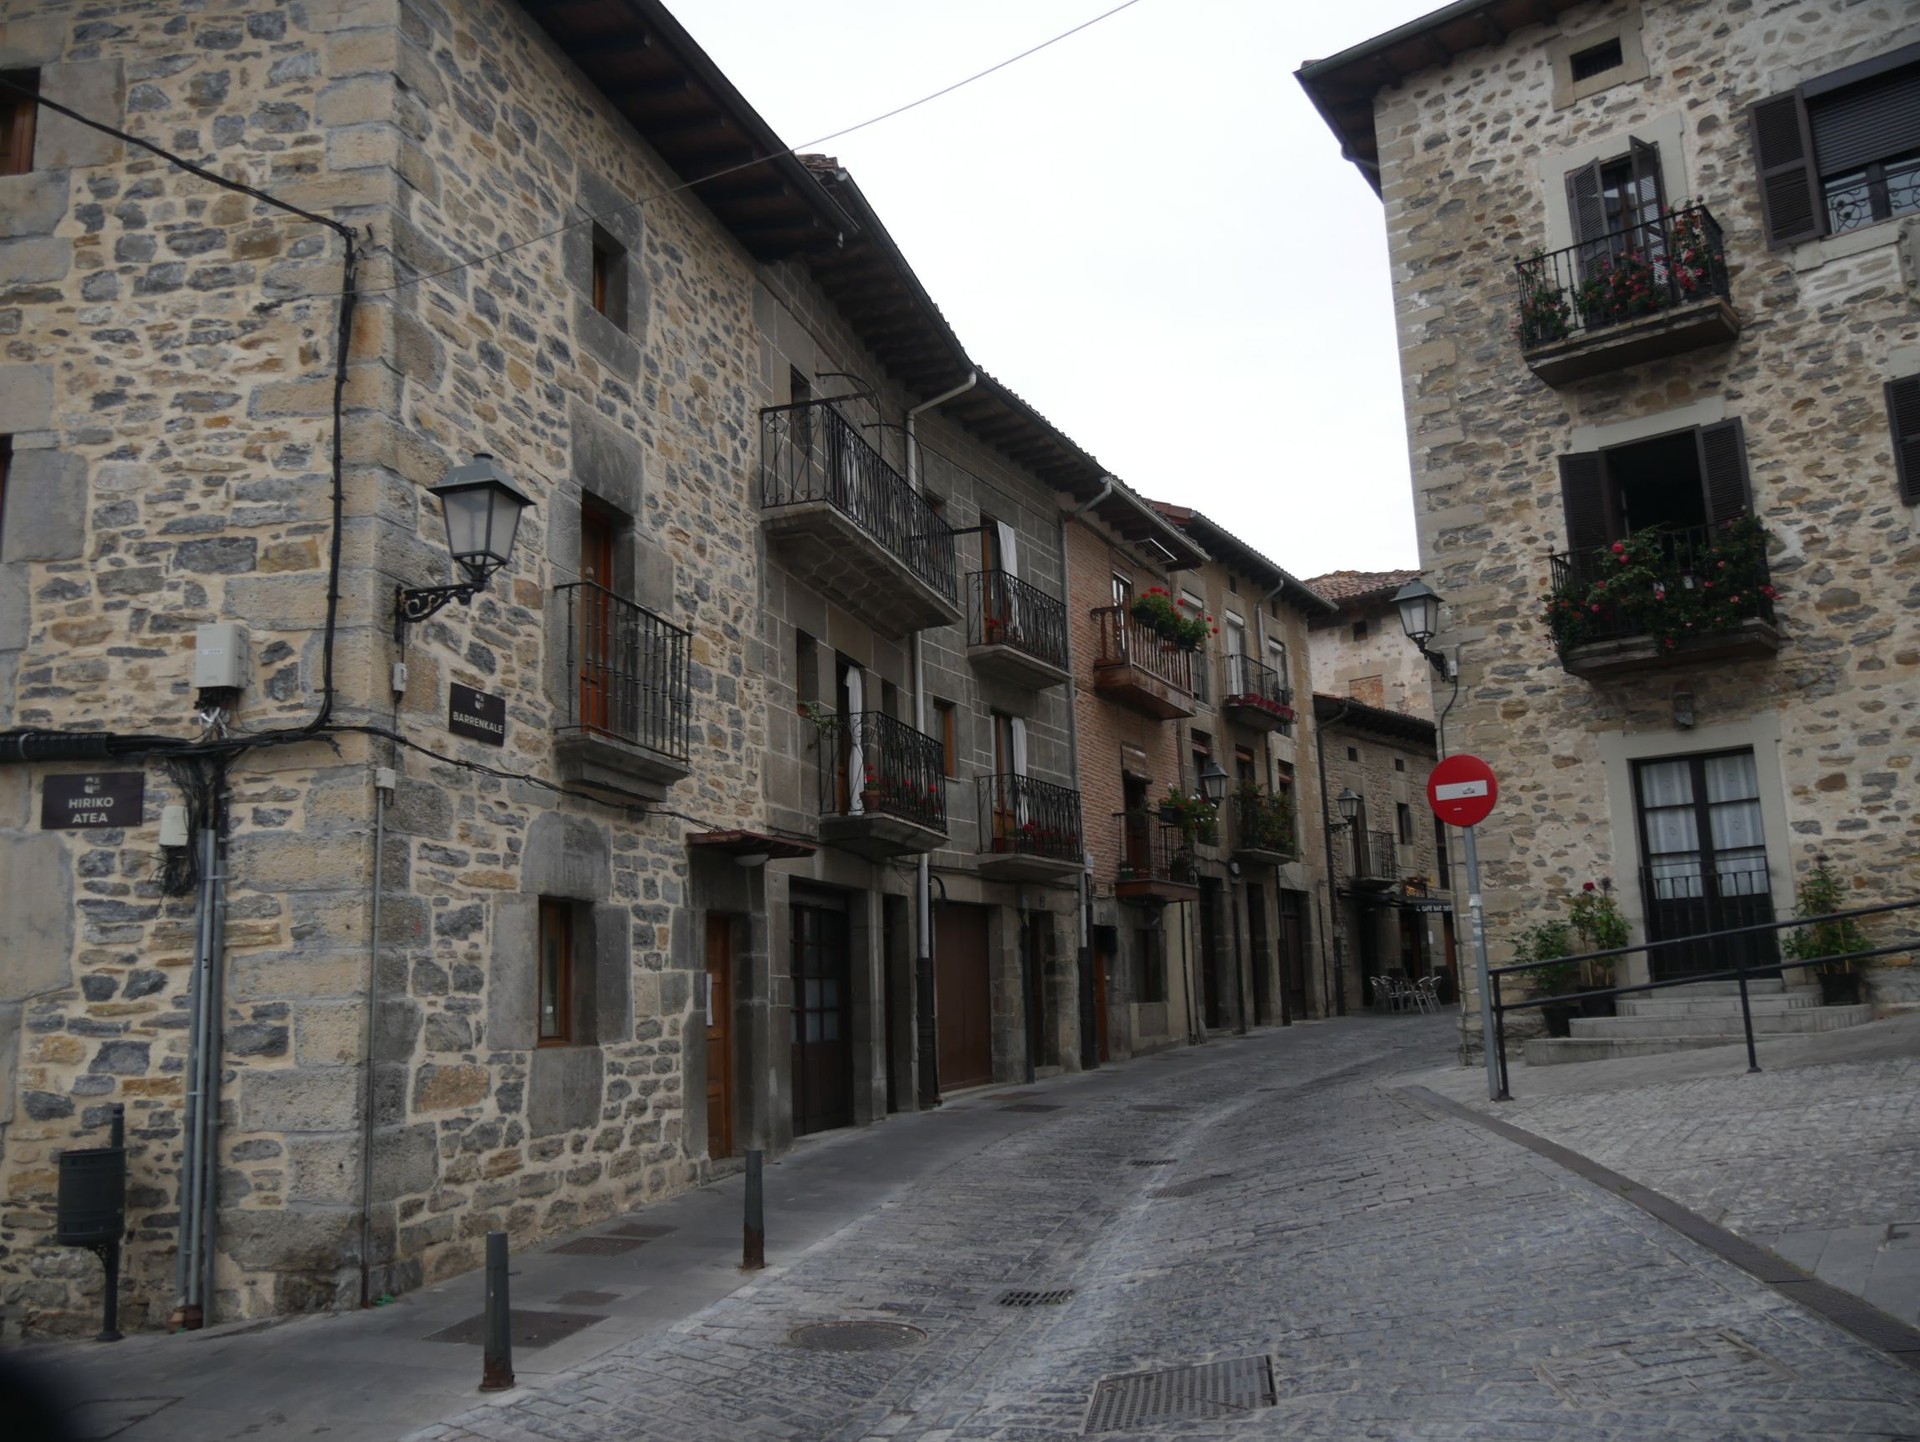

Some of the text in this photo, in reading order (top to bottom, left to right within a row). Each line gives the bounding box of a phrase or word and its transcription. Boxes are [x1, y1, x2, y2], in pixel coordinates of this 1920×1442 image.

[453, 711, 504, 734] BARRENKALE
[68, 797, 114, 808] HIRIKO
[72, 813, 108, 824] ATEA
